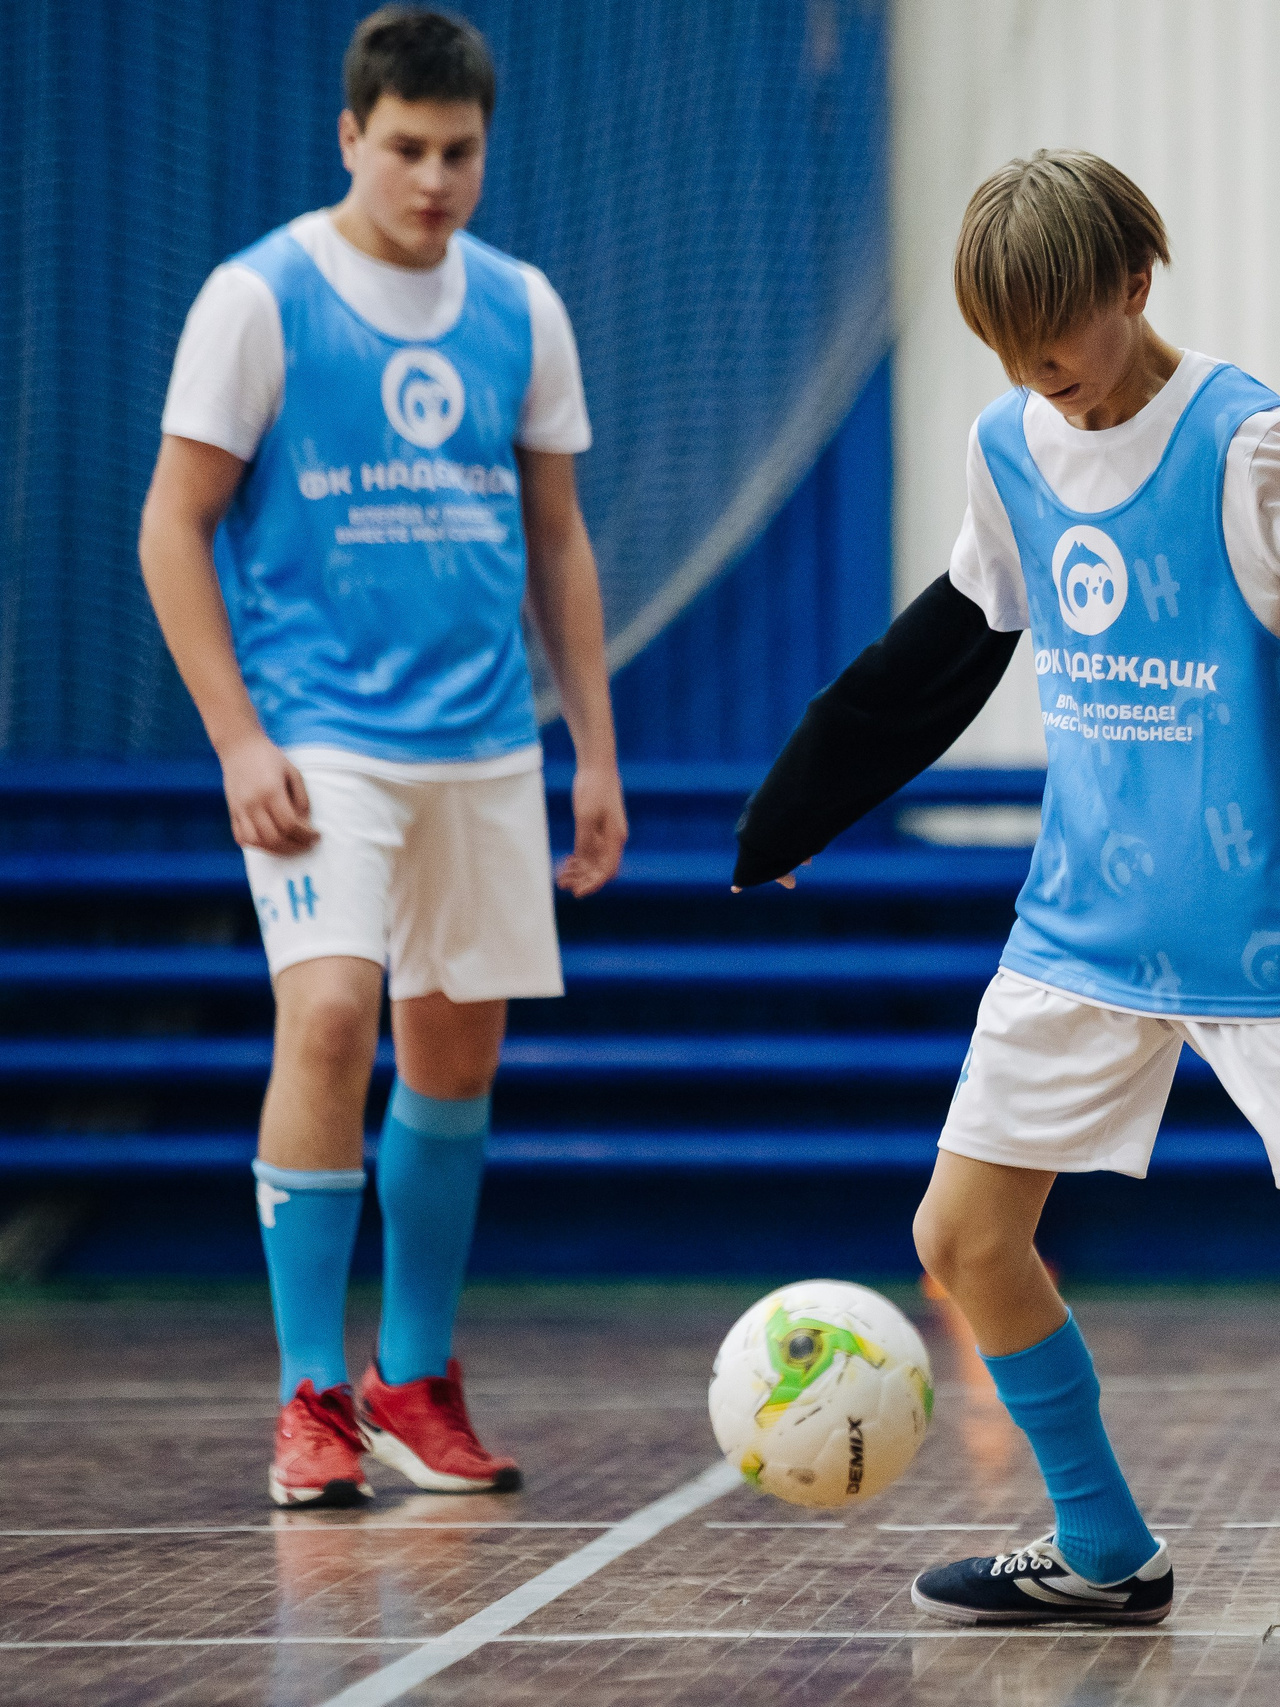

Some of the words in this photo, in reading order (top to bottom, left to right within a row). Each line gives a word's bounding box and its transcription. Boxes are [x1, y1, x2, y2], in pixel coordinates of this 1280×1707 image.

[1034, 648, 1063, 676] ФК
[1082, 703, 1095, 719] К
[1096, 702, 1176, 723] ПОБЕДЕ!
[1102, 724, 1193, 742] СИЛЬНЕЕ!
[846, 1415, 864, 1495] DEMIX
